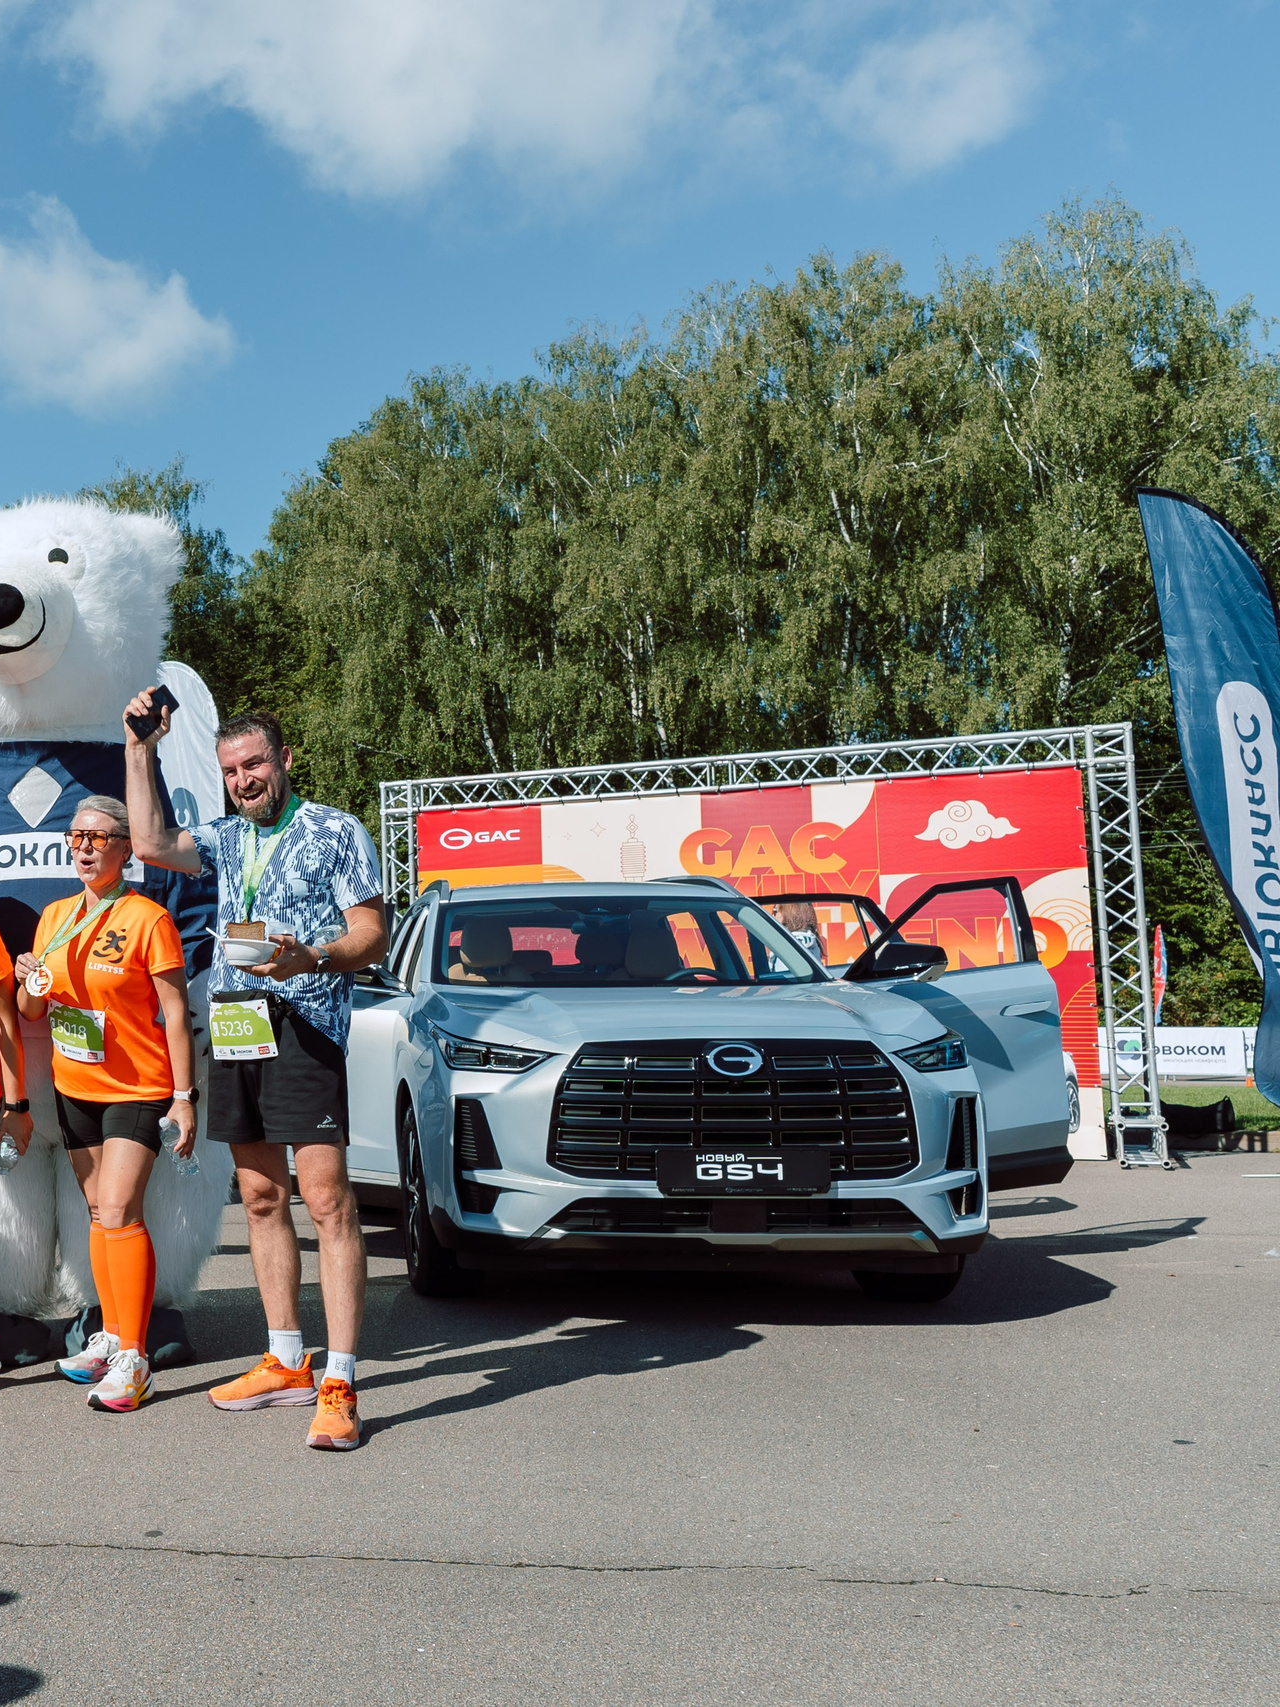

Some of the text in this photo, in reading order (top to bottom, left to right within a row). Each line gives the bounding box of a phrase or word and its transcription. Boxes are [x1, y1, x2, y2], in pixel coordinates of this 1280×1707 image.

[474, 829, 520, 843] GAC
[679, 821, 847, 878] GAC
[88, 961, 125, 975] LIPETSK
[57, 1019, 87, 1040] 5018
[220, 1020, 253, 1037] 5236
[696, 1153, 745, 1162] НОВЫЙ
[696, 1163, 784, 1181] GS4
